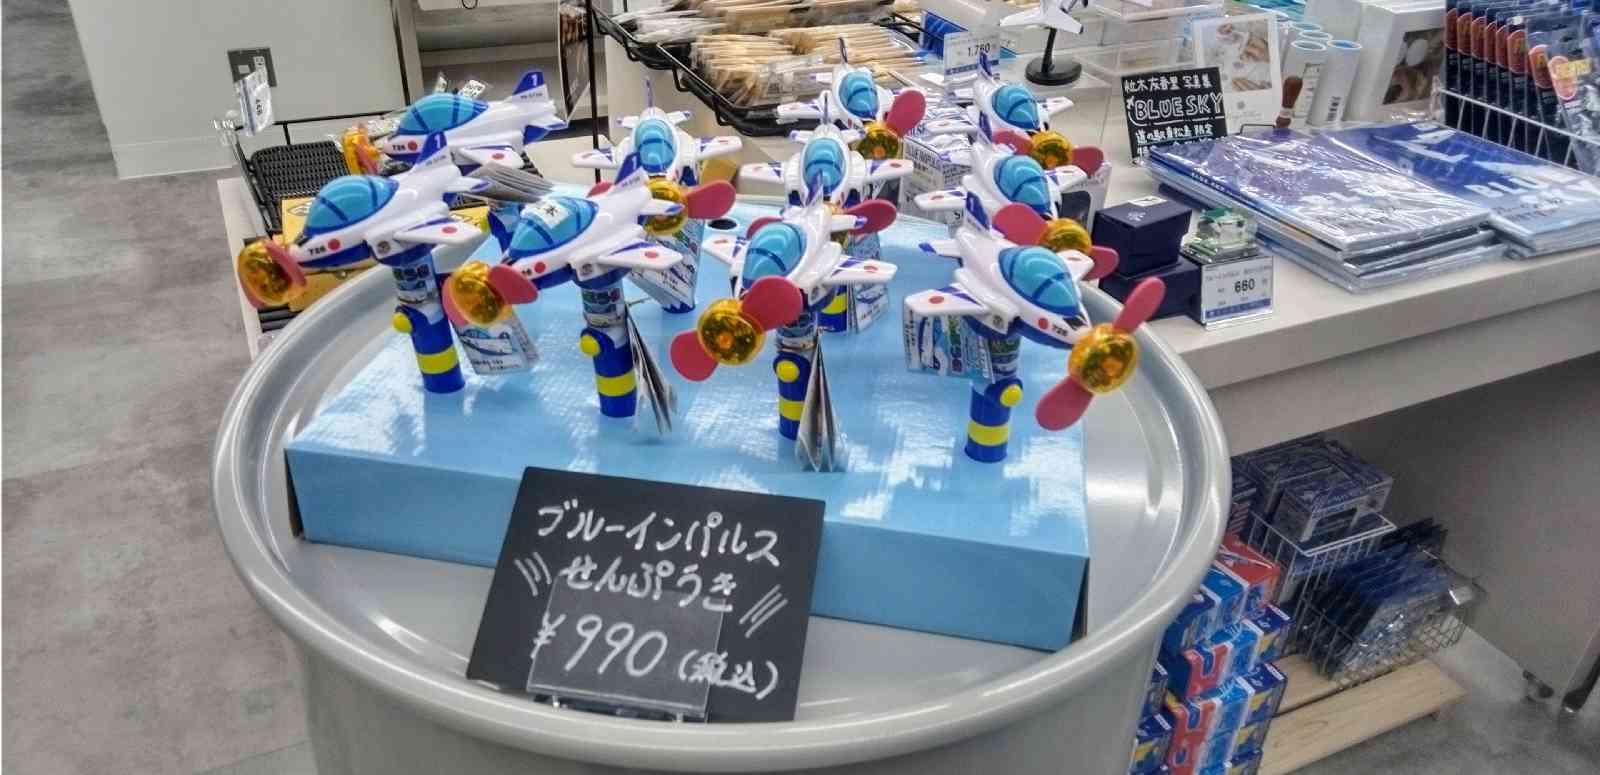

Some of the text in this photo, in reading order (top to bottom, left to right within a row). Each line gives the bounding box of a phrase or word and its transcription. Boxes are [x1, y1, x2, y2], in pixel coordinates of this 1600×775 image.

[1134, 91, 1224, 121] BLUE SKY
[1234, 278, 1256, 293] 660
[537, 498, 780, 567] ブルーインパルス
[558, 554, 737, 612] せんぷうき
